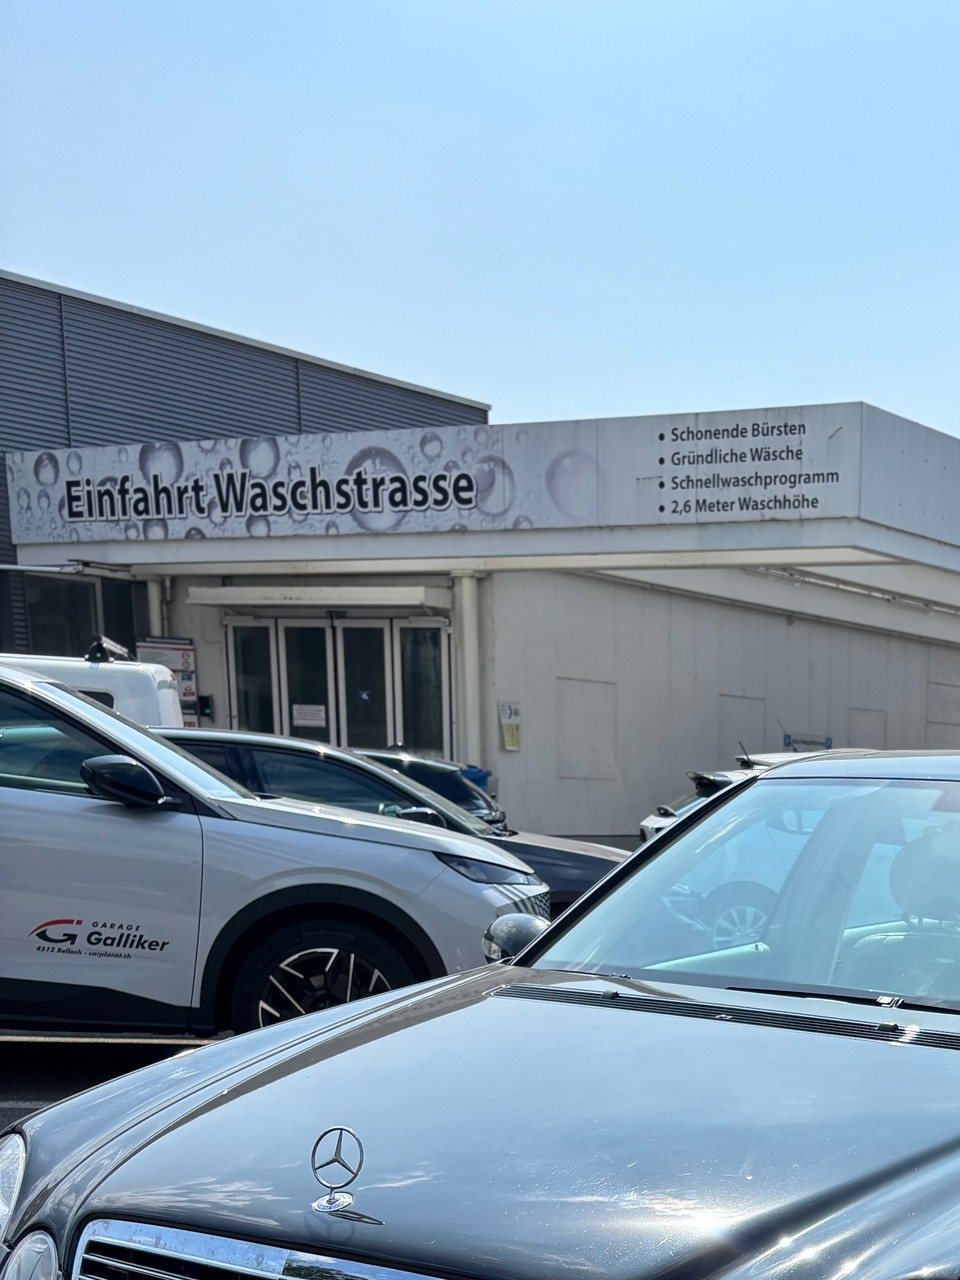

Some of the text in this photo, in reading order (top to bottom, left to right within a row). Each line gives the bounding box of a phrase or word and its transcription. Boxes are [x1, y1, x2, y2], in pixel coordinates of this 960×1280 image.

[670, 422, 806, 442] Schonende Bürsten
[670, 445, 803, 466] Gründliche Wäsche
[670, 469, 840, 490] Schnellwaschprogramm
[65, 466, 476, 520] Einfahrt Waschstrasse
[670, 493, 819, 516] 2,6 Meter Waschhöhe
[91, 920, 142, 932] GARAGE
[56, 946, 83, 955] Bellach
[86, 931, 170, 951] Galliker
